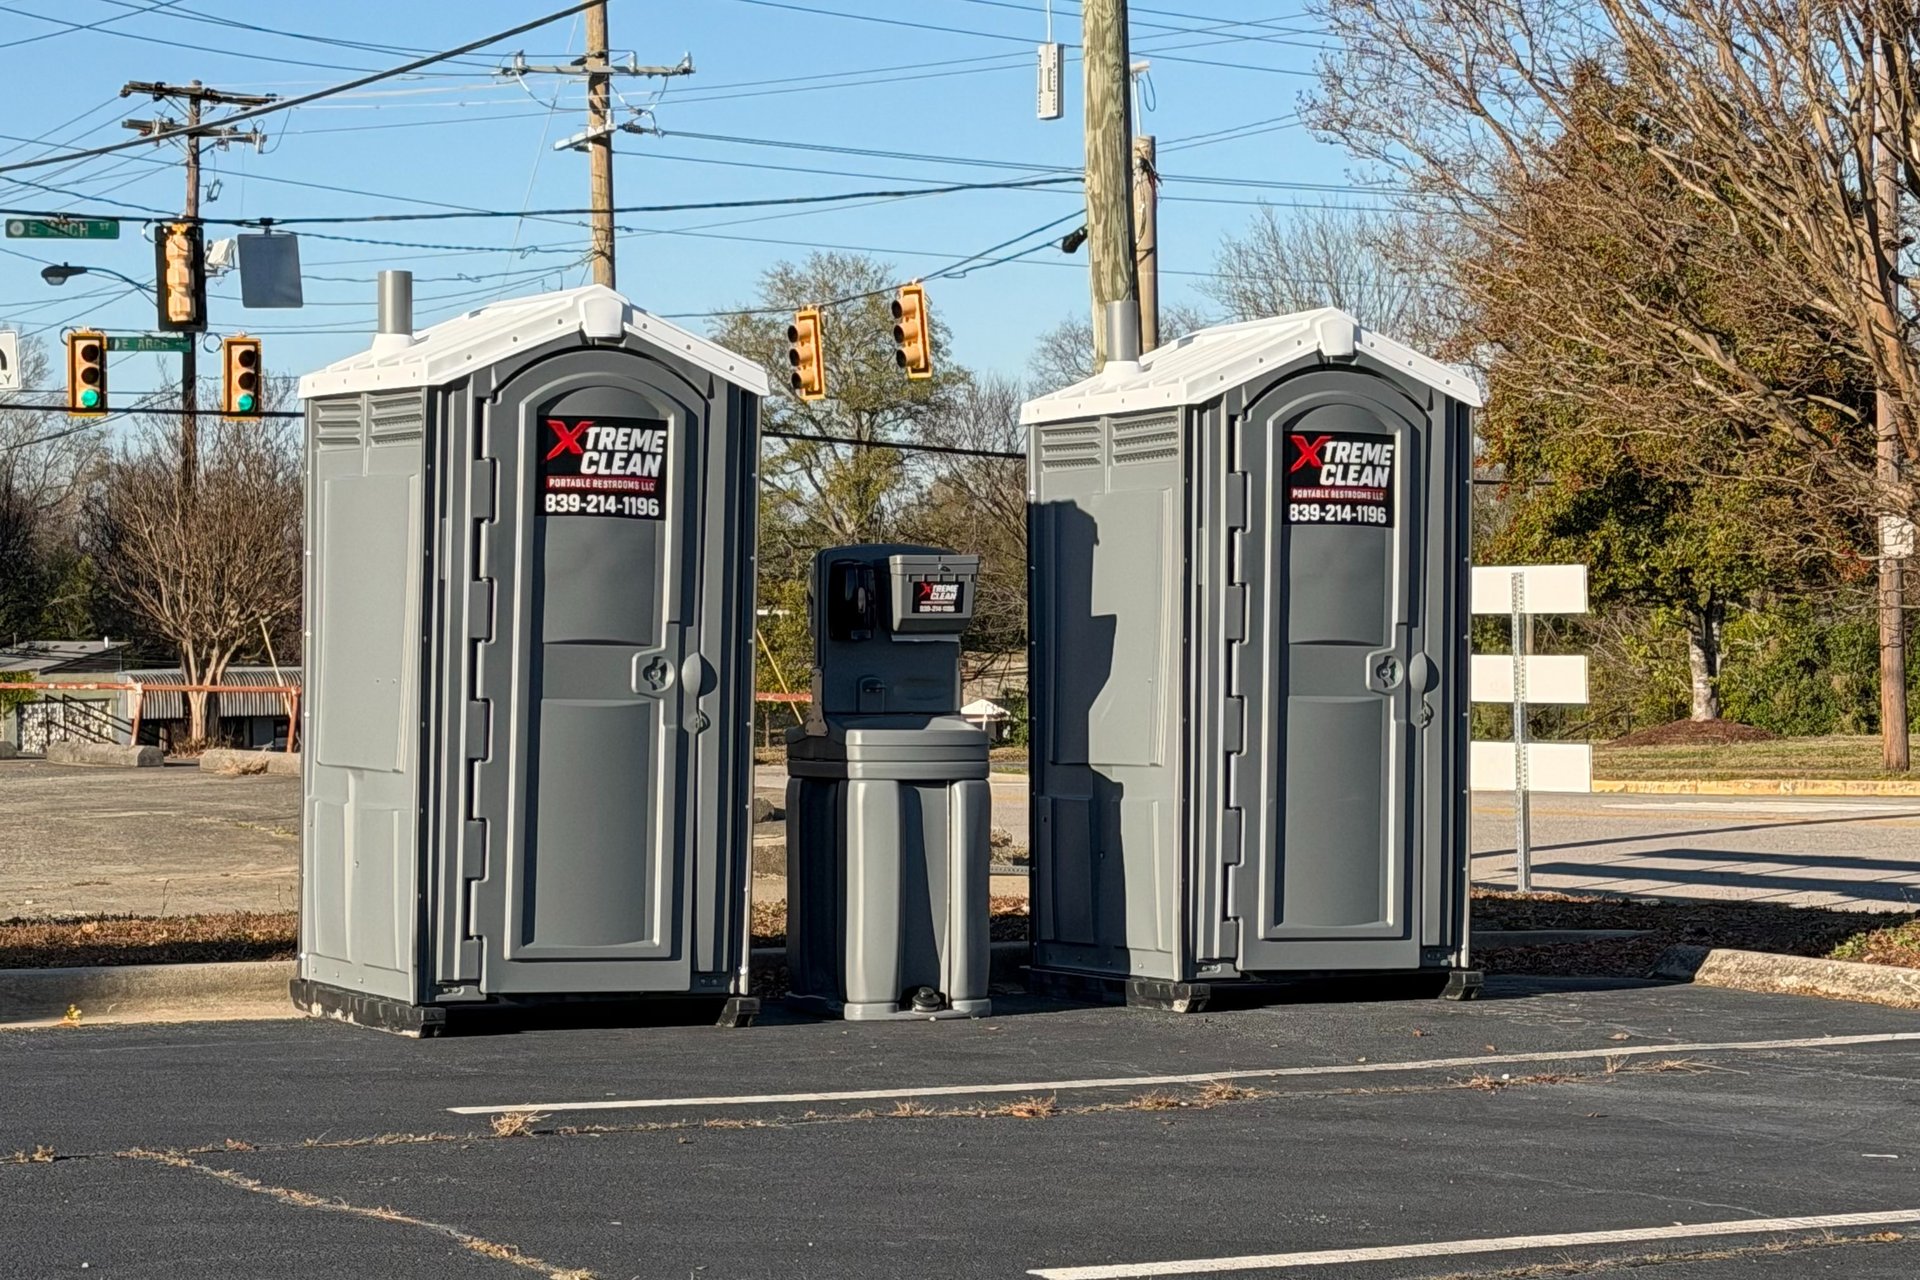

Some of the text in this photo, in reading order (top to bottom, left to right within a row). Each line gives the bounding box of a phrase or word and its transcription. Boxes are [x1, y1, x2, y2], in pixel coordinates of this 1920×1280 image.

[544, 419, 667, 461] XTREME
[580, 451, 662, 478] CLEAN
[1289, 434, 1394, 474] XTREME
[548, 478, 655, 492] PORTABLE RESTROOMS LLC
[1320, 464, 1390, 488] CLEAN
[544, 493, 660, 517] 839-214-1196
[1292, 488, 1384, 501] PORTABLE RESTROOMS LLC
[1289, 503, 1387, 524] 839-214-1196
[919, 582, 959, 597] XTREME
[930, 592, 957, 600] CLEAN
